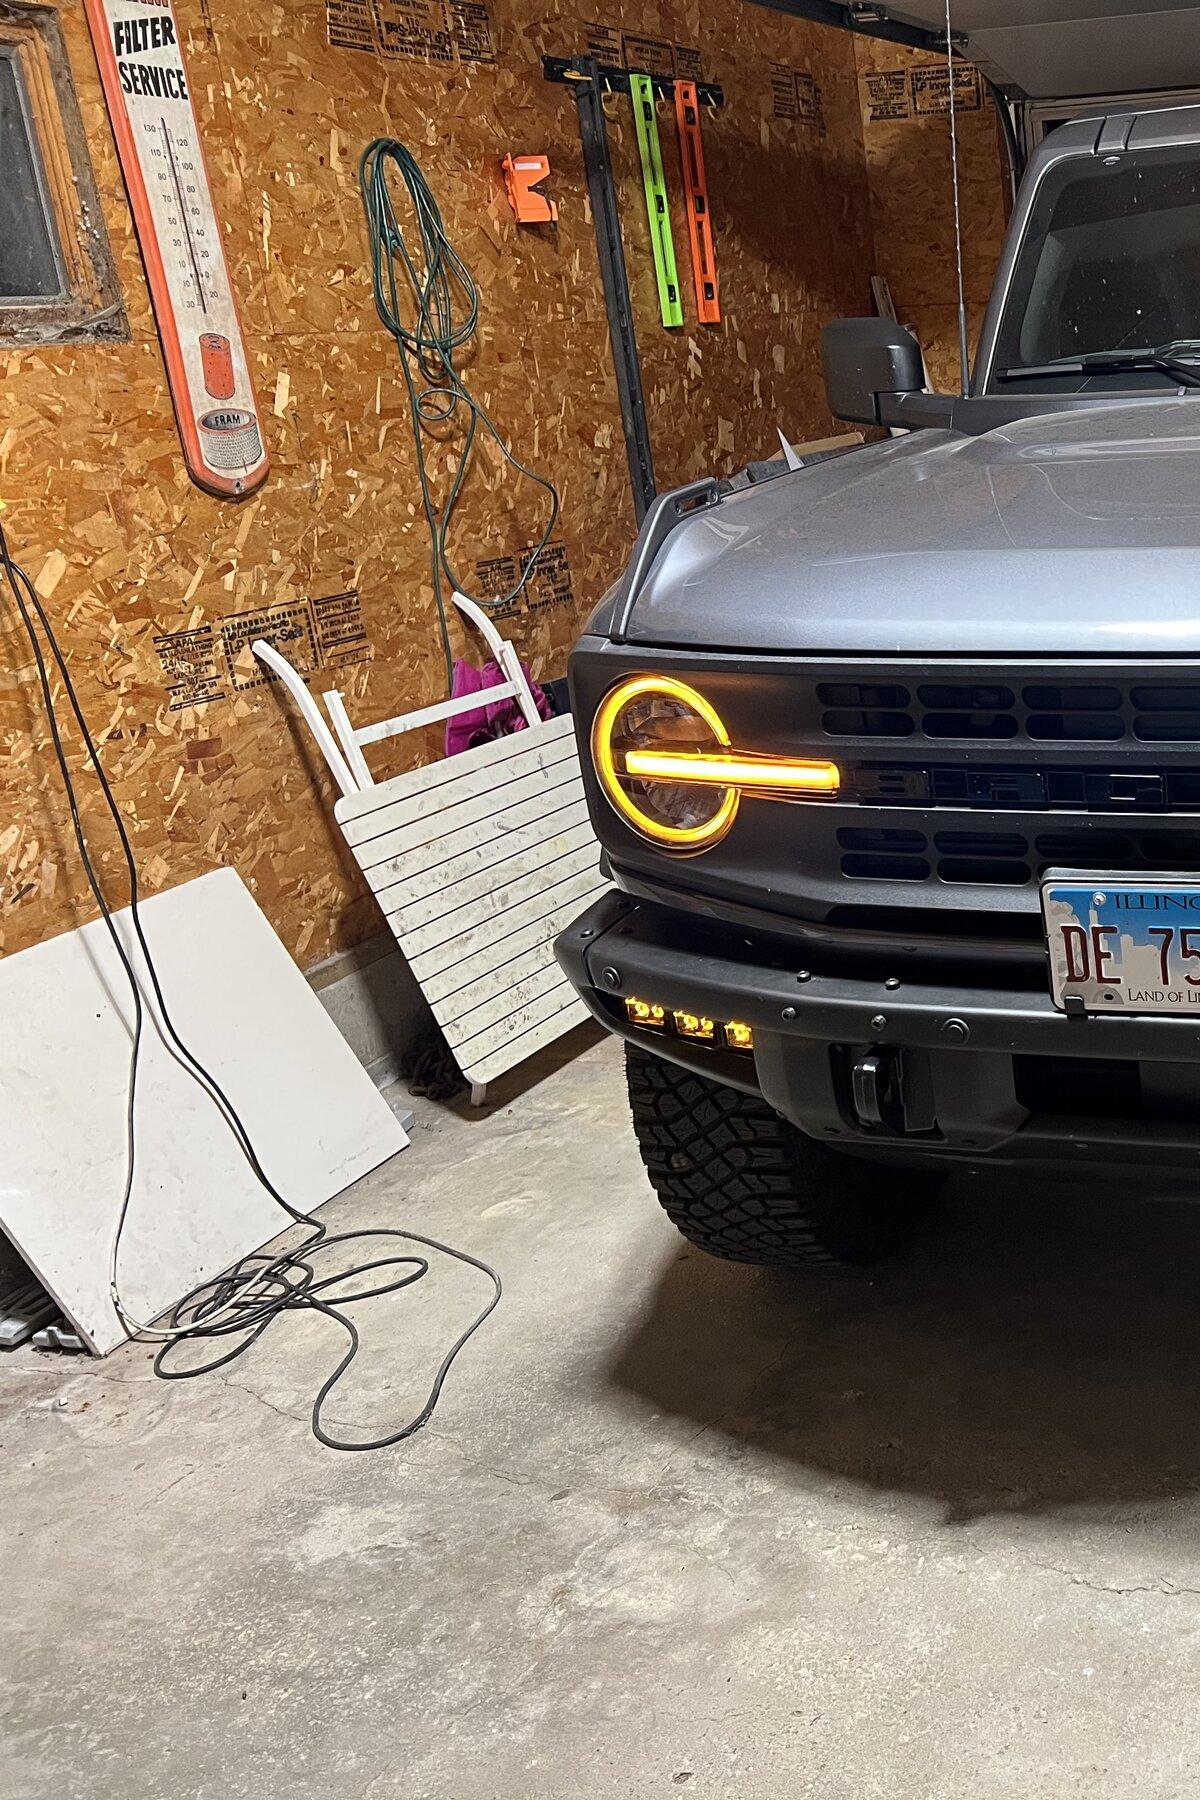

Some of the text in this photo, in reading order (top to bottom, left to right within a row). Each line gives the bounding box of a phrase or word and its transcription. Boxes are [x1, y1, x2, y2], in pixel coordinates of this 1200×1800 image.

[113, 16, 176, 56] FILTER
[118, 61, 189, 100] SERVICE
[144, 124, 156, 133] 130
[177, 139, 188, 147] 120
[158, 173, 167, 181] 90
[186, 185, 195, 193] 80
[163, 195, 172, 203] 70
[168, 217, 177, 225] 50
[196, 229, 205, 237] 40
[173, 239, 181, 247] 30
[201, 250, 209, 258] 20
[179, 260, 186, 268] 10
[214, 414, 241, 426] FRAM
[1060, 925, 1122, 985] DE
[1128, 988, 1165, 1002] LAND
